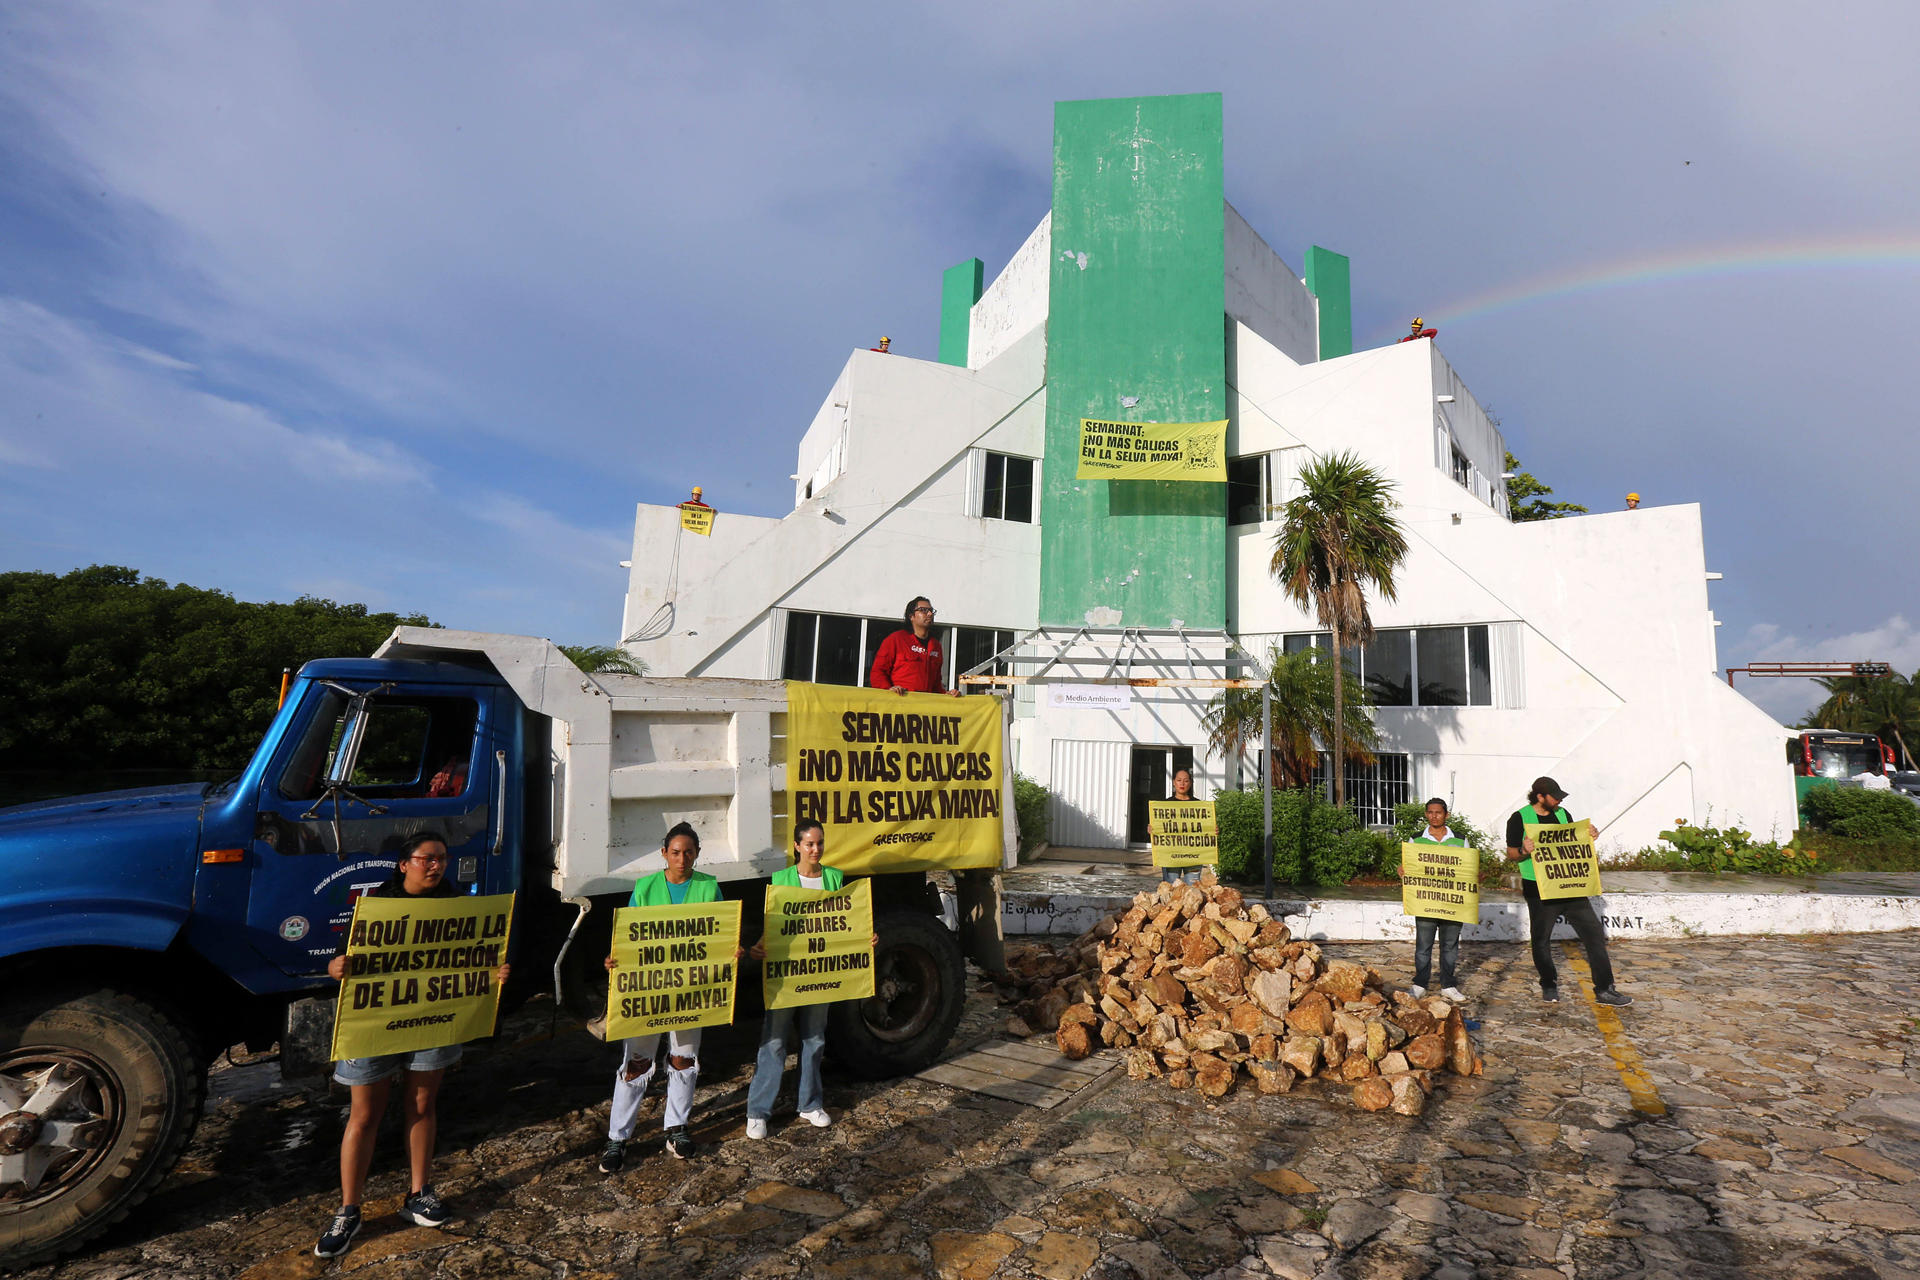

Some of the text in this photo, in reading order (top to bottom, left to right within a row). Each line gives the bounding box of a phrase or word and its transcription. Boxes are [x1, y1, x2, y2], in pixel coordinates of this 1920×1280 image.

[1085, 421, 1145, 437] SEMARNAT:
[1083, 434, 1179, 451] ¡NO MÁS CALICAS
[1082, 446, 1183, 463] EN LA SELVA MAYA!
[1087, 695, 1121, 703] Ambiente
[842, 711, 961, 745] SEMARNAT
[799, 745, 993, 782] ¡NO MÁS CALICAS
[795, 788, 1000, 824] EN LA SELVA MAYA!
[1153, 808, 1211, 819] TREN MAYA:
[1163, 820, 1202, 833] VÍA A LA
[873, 832, 935, 846] GREENPEACE
[1153, 834, 1216, 847] DESTRUCCIÓN
[1418, 853, 1462, 865] SEMARNAT:
[1534, 844, 1592, 863] ¿EL NUEVO
[331, 864, 356, 881] NACIONAL
[356, 861, 364, 870] DE
[1424, 866, 1455, 877] NO MÁS
[1545, 862, 1590, 880] CALICA?
[1403, 876, 1477, 893] DESTRUCCIÓN DE LA
[783, 895, 852, 916] QUEREMOS
[1416, 890, 1464, 904] NATURALEZA
[351, 913, 507, 948] AQUÍ INICIA LA
[629, 916, 720, 942] SEMARNAT:
[780, 915, 852, 936] JAGUARES,
[638, 938, 707, 967] ¡NO MÁS
[808, 937, 826, 954] NO
[350, 940, 500, 976] DEVASTACIÓN
[766, 952, 870, 979] EXTRACTIVISMO
[617, 963, 732, 993] CALICAS EN LA
[795, 981, 842, 993] GREENPEACE
[353, 970, 491, 1010] DE LA SELVA
[621, 987, 728, 1019] SELVA MAYA!
[385, 1013, 456, 1031] GREENPEACE
[646, 1014, 702, 1028] GREENPEACE
